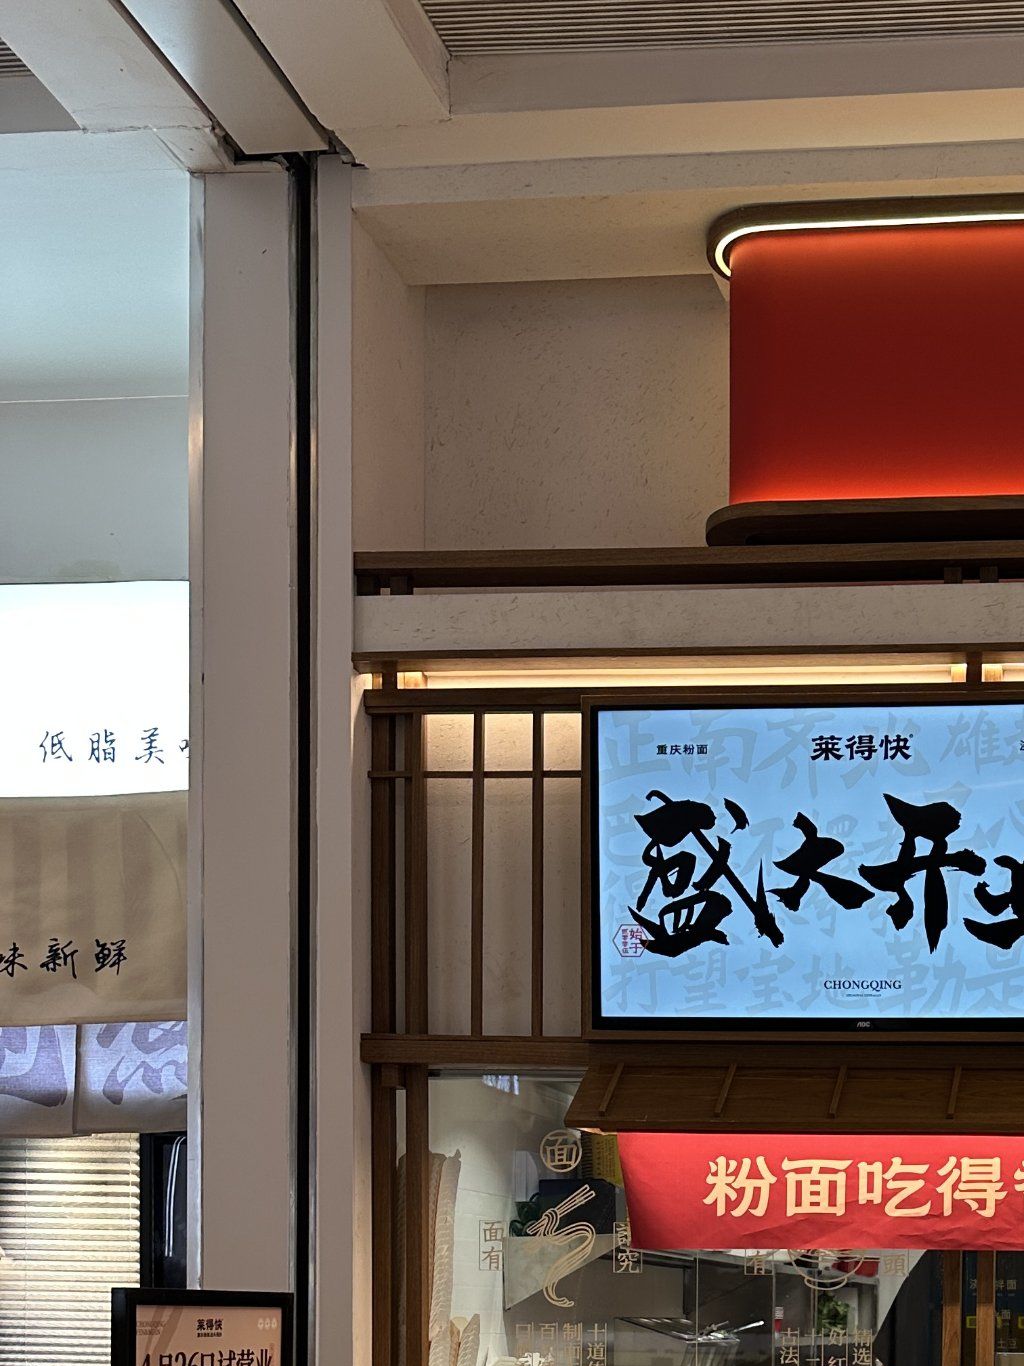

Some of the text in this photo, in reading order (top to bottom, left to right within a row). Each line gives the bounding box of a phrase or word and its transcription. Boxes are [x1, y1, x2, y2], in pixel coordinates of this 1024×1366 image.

[656, 743, 708, 756] 重庆粉面
[810, 734, 914, 761] 莱得快
[823, 979, 902, 992] CHONGQING
[196, 1318, 223, 1331] 莱得快
